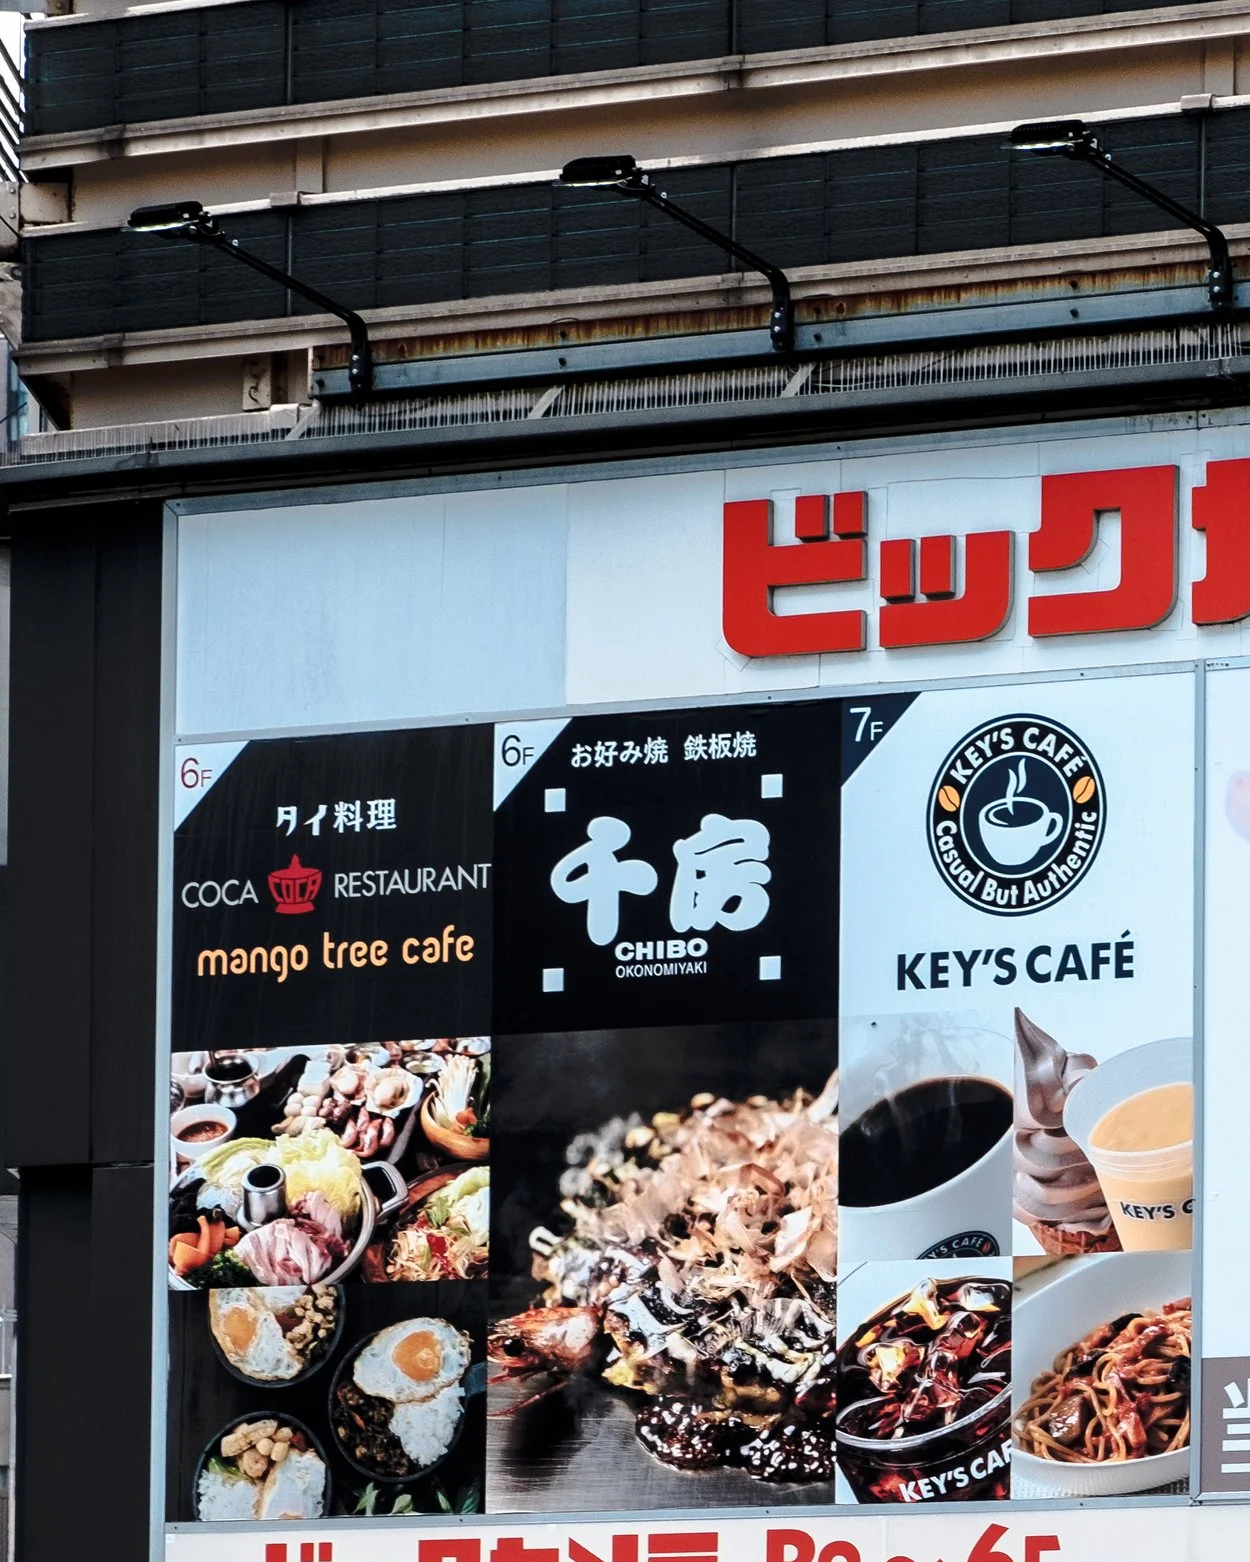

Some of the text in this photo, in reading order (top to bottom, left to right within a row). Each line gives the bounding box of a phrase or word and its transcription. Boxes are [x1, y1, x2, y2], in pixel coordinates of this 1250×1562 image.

[850, 706, 884, 742] 7F
[501, 734, 535, 767] 6F
[570, 731, 757, 769] お好み焼 鉄板焼
[950, 727, 1013, 785] KEY'S
[180, 757, 213, 789] 6F
[276, 798, 398, 836] タイ料理
[936, 810, 1098, 906] Casual But Authentic
[181, 863, 492, 908] COCA RESTAURANT
[550, 813, 772, 946] 千房
[197, 925, 475, 984] mango tree cafe
[614, 938, 709, 961] CHIBO
[897, 929, 1135, 991] KEY'S CAFÉ
[615, 961, 708, 979] OKONOMIYAKI
[1120, 1201, 1176, 1220] KEY'S
[898, 1466, 969, 1503] KEY'S
